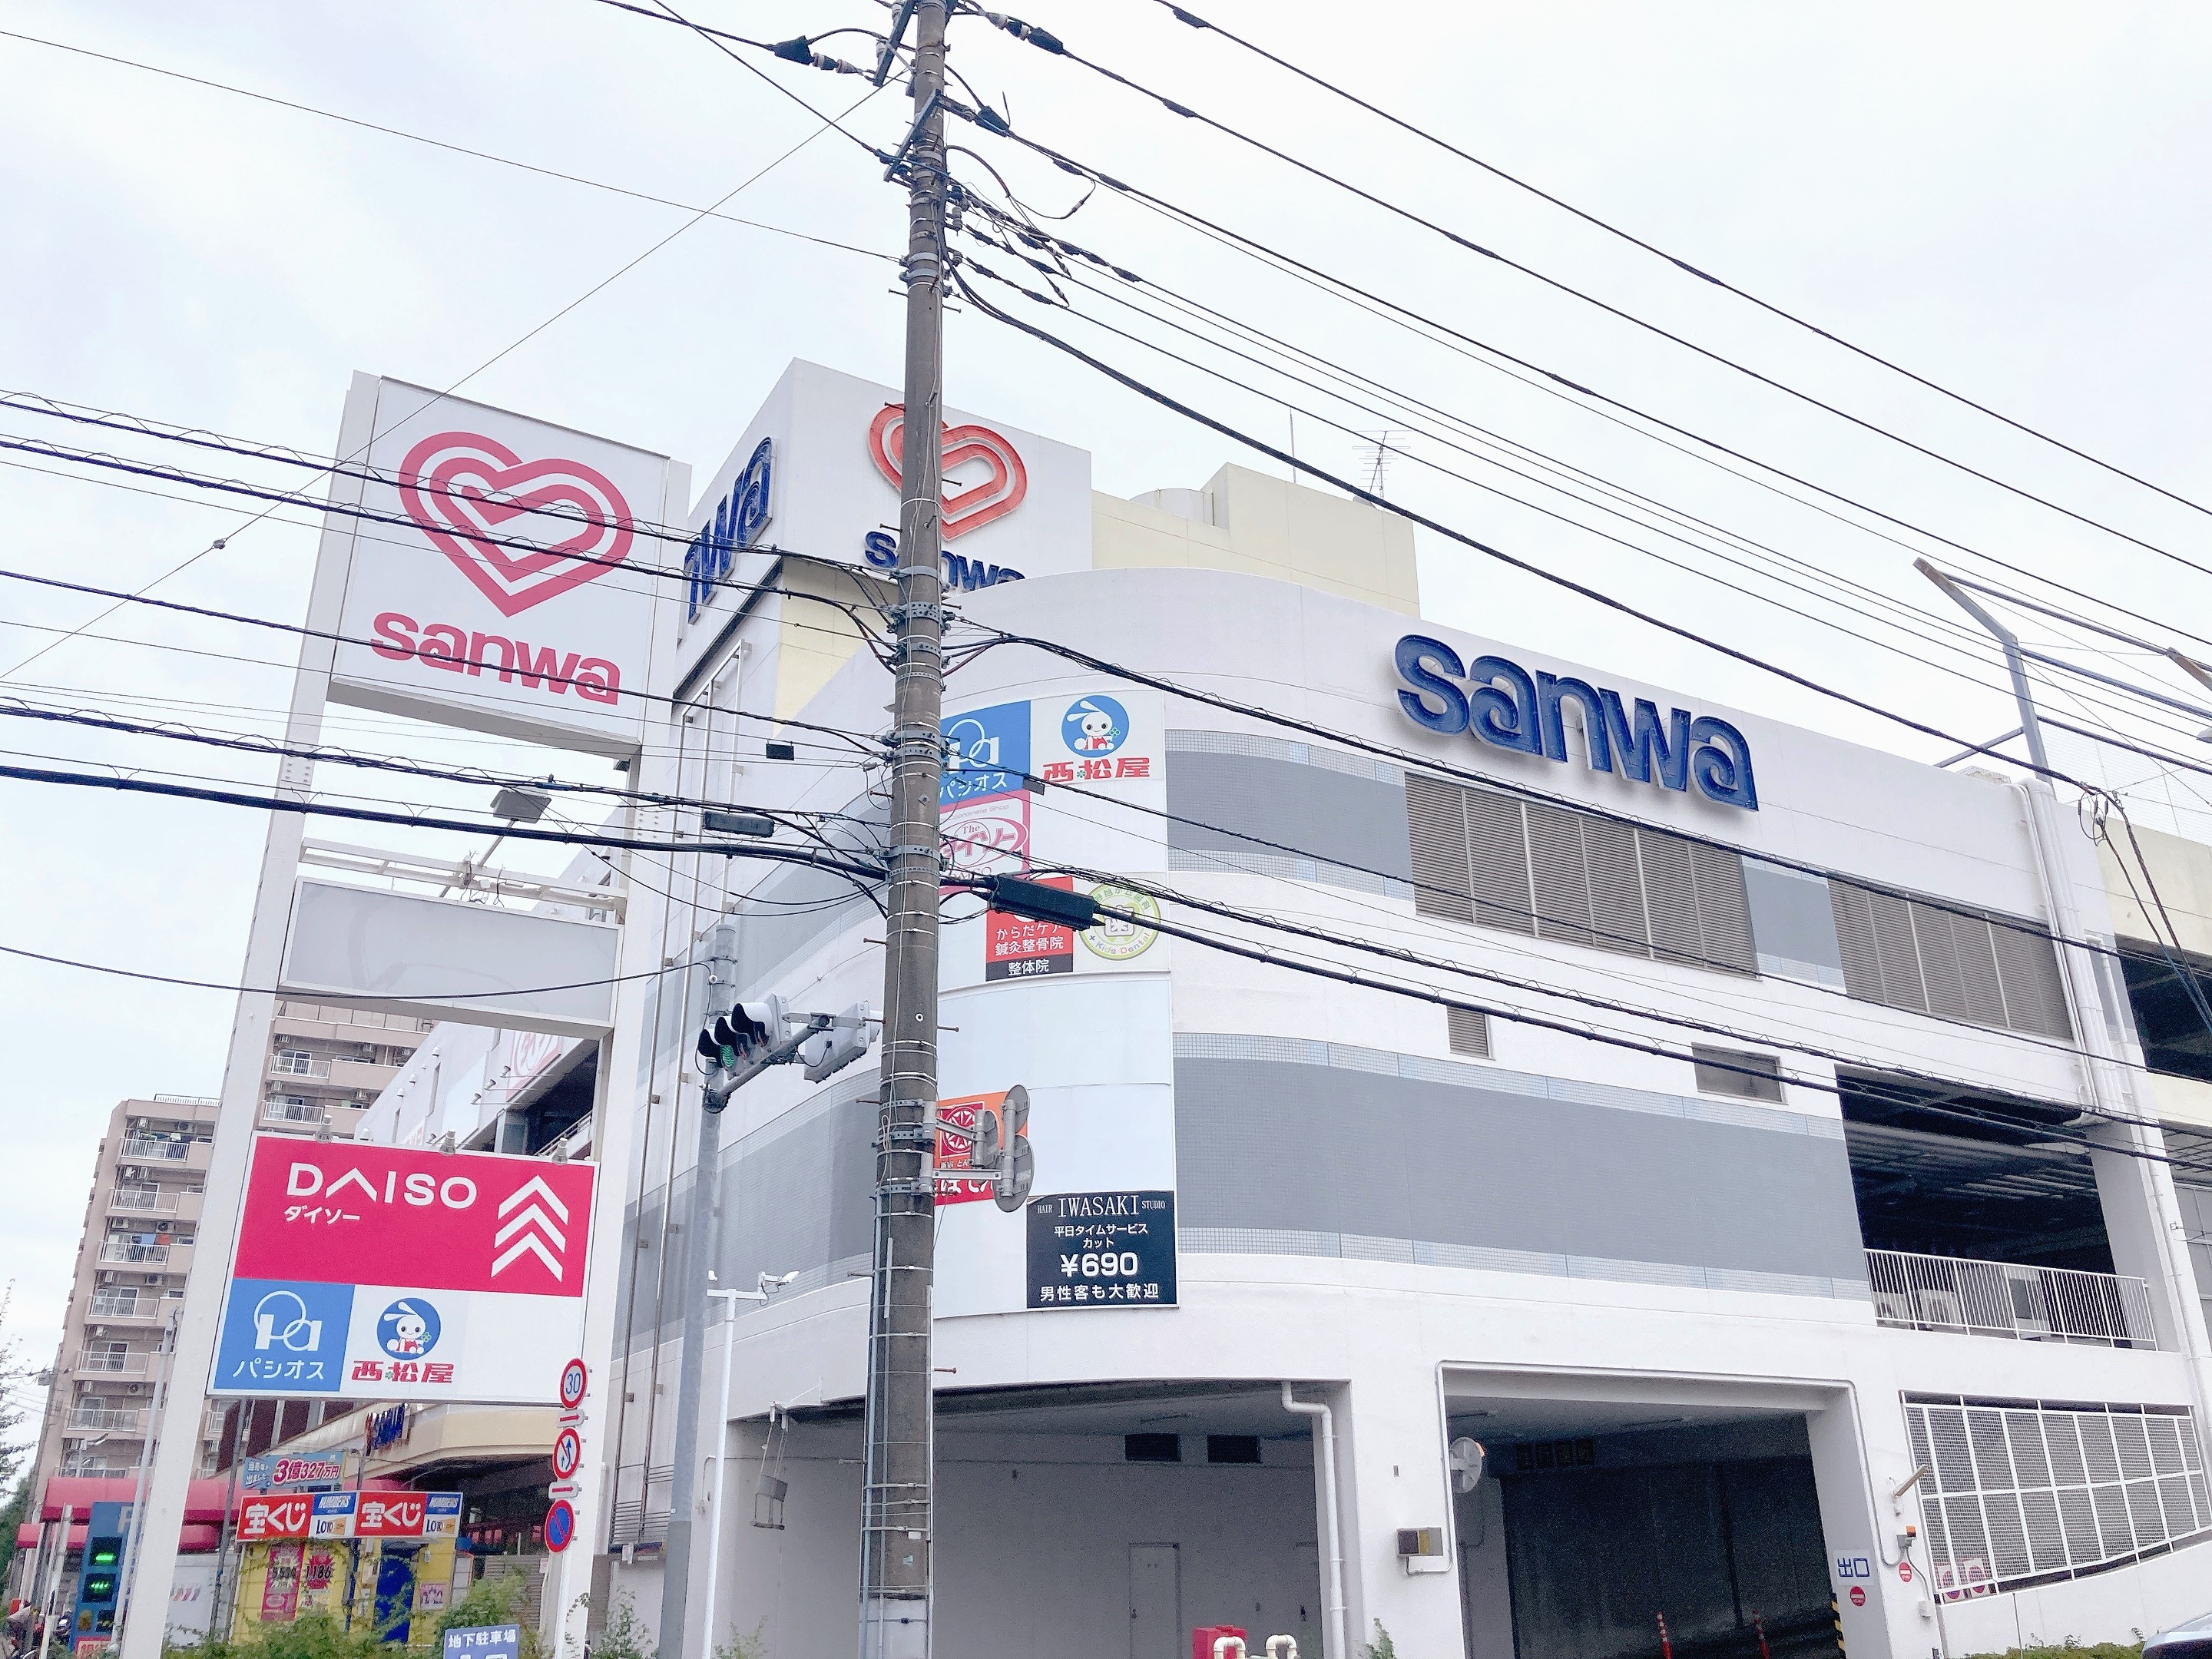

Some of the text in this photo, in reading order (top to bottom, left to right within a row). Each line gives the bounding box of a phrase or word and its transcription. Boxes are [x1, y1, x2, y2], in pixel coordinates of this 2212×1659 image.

[370, 611, 621, 706] sanwa
[1392, 634, 1759, 811] sanwa
[1041, 757, 1151, 783] 西松屋
[989, 803, 1009, 813] Shop
[962, 825, 981, 835] The
[995, 935, 1064, 956] 鍼灸整骨院
[1095, 932, 1151, 955] Kids Dental
[1008, 958, 1049, 976] 整体院
[286, 1162, 477, 1210] DAISO
[283, 1204, 360, 1224] ダイソー
[1036, 1194, 1166, 1218] HAIR IWASAKI STUDIO
[1053, 1223, 1148, 1237] 平日タイムサービス
[1082, 1237, 1114, 1249] カット
[1060, 1252, 1139, 1278] ¥690
[1040, 1283, 1159, 1303] 男性客も大歓迎
[233, 1358, 325, 1381] パシオス
[351, 1359, 455, 1384] 西松屋
[564, 1372, 581, 1396] 30
[243, 1502, 306, 1535] 宝くじ
[360, 1501, 422, 1528] 宝くじ
[1837, 1557, 1870, 1578] 出口
[448, 1628, 516, 1650] 地下駐車場
